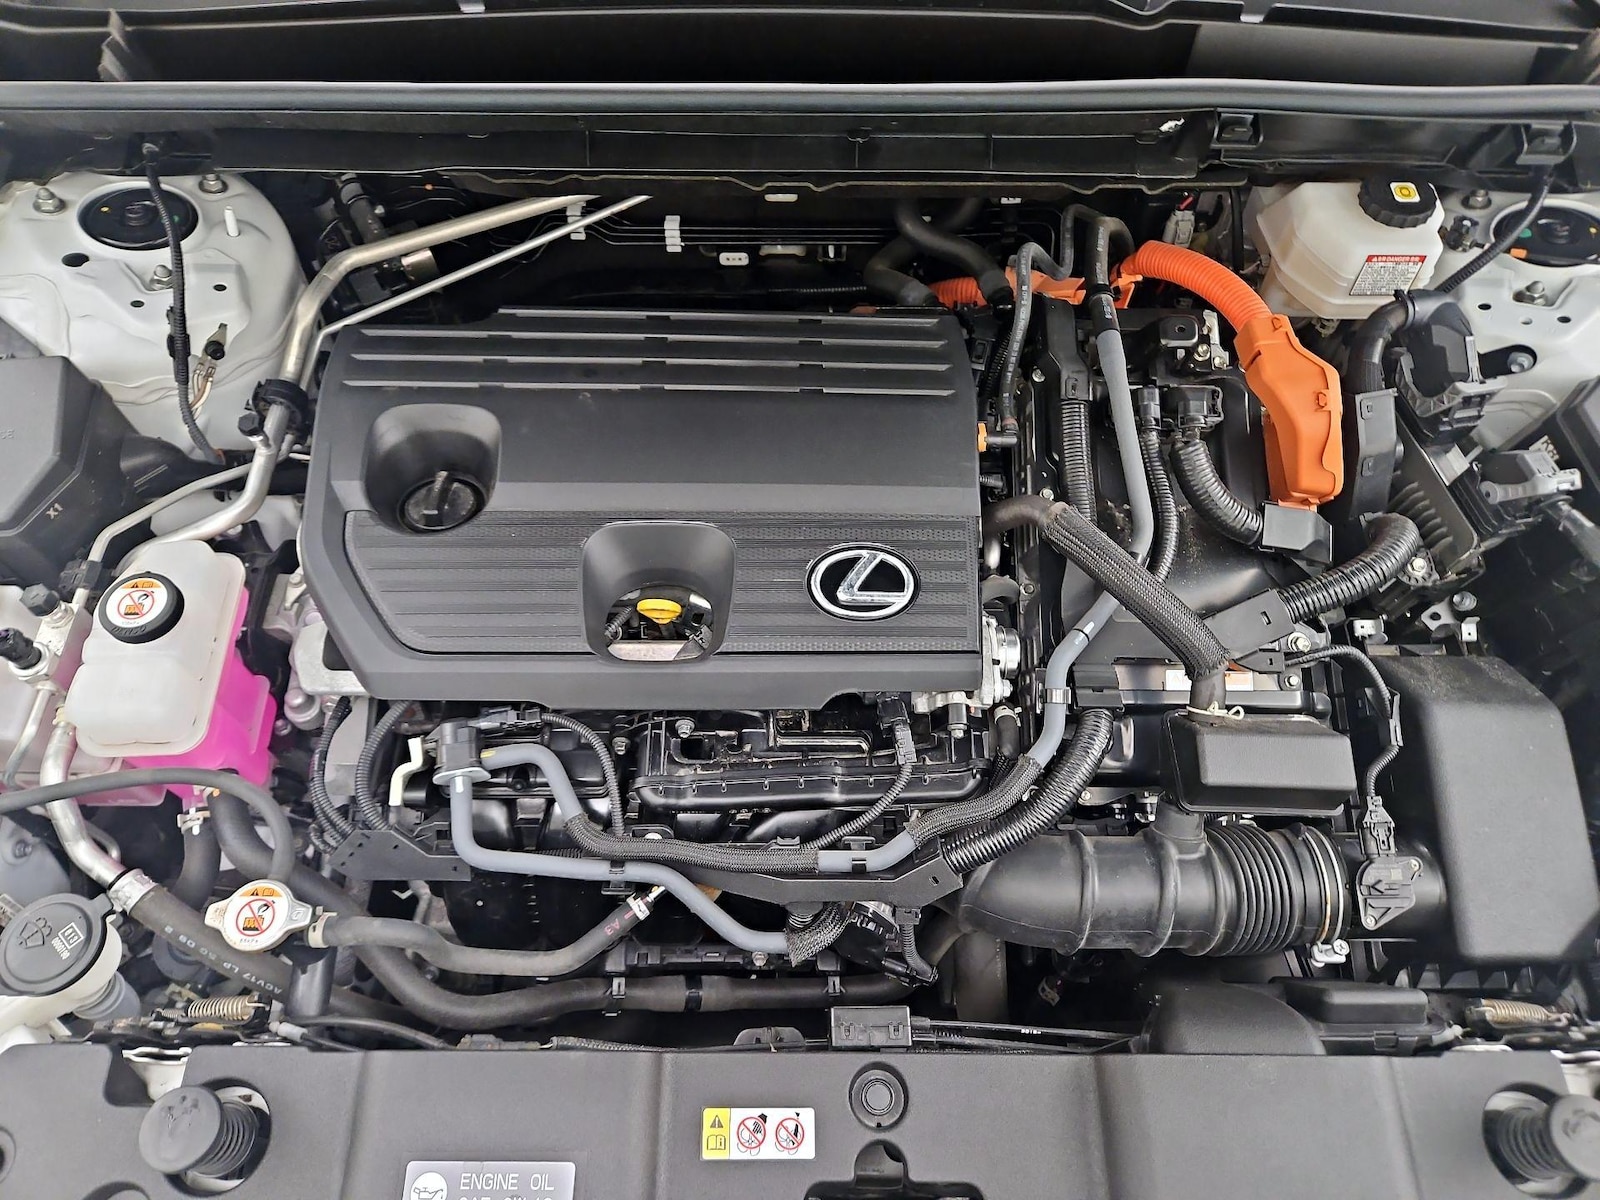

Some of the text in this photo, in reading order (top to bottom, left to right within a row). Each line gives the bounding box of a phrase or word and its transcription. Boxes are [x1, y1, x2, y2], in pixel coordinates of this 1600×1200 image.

[46, 503, 63, 519] X1
[604, 917, 620, 935] A3
[460, 1173, 555, 1191] ENGINE OIL
